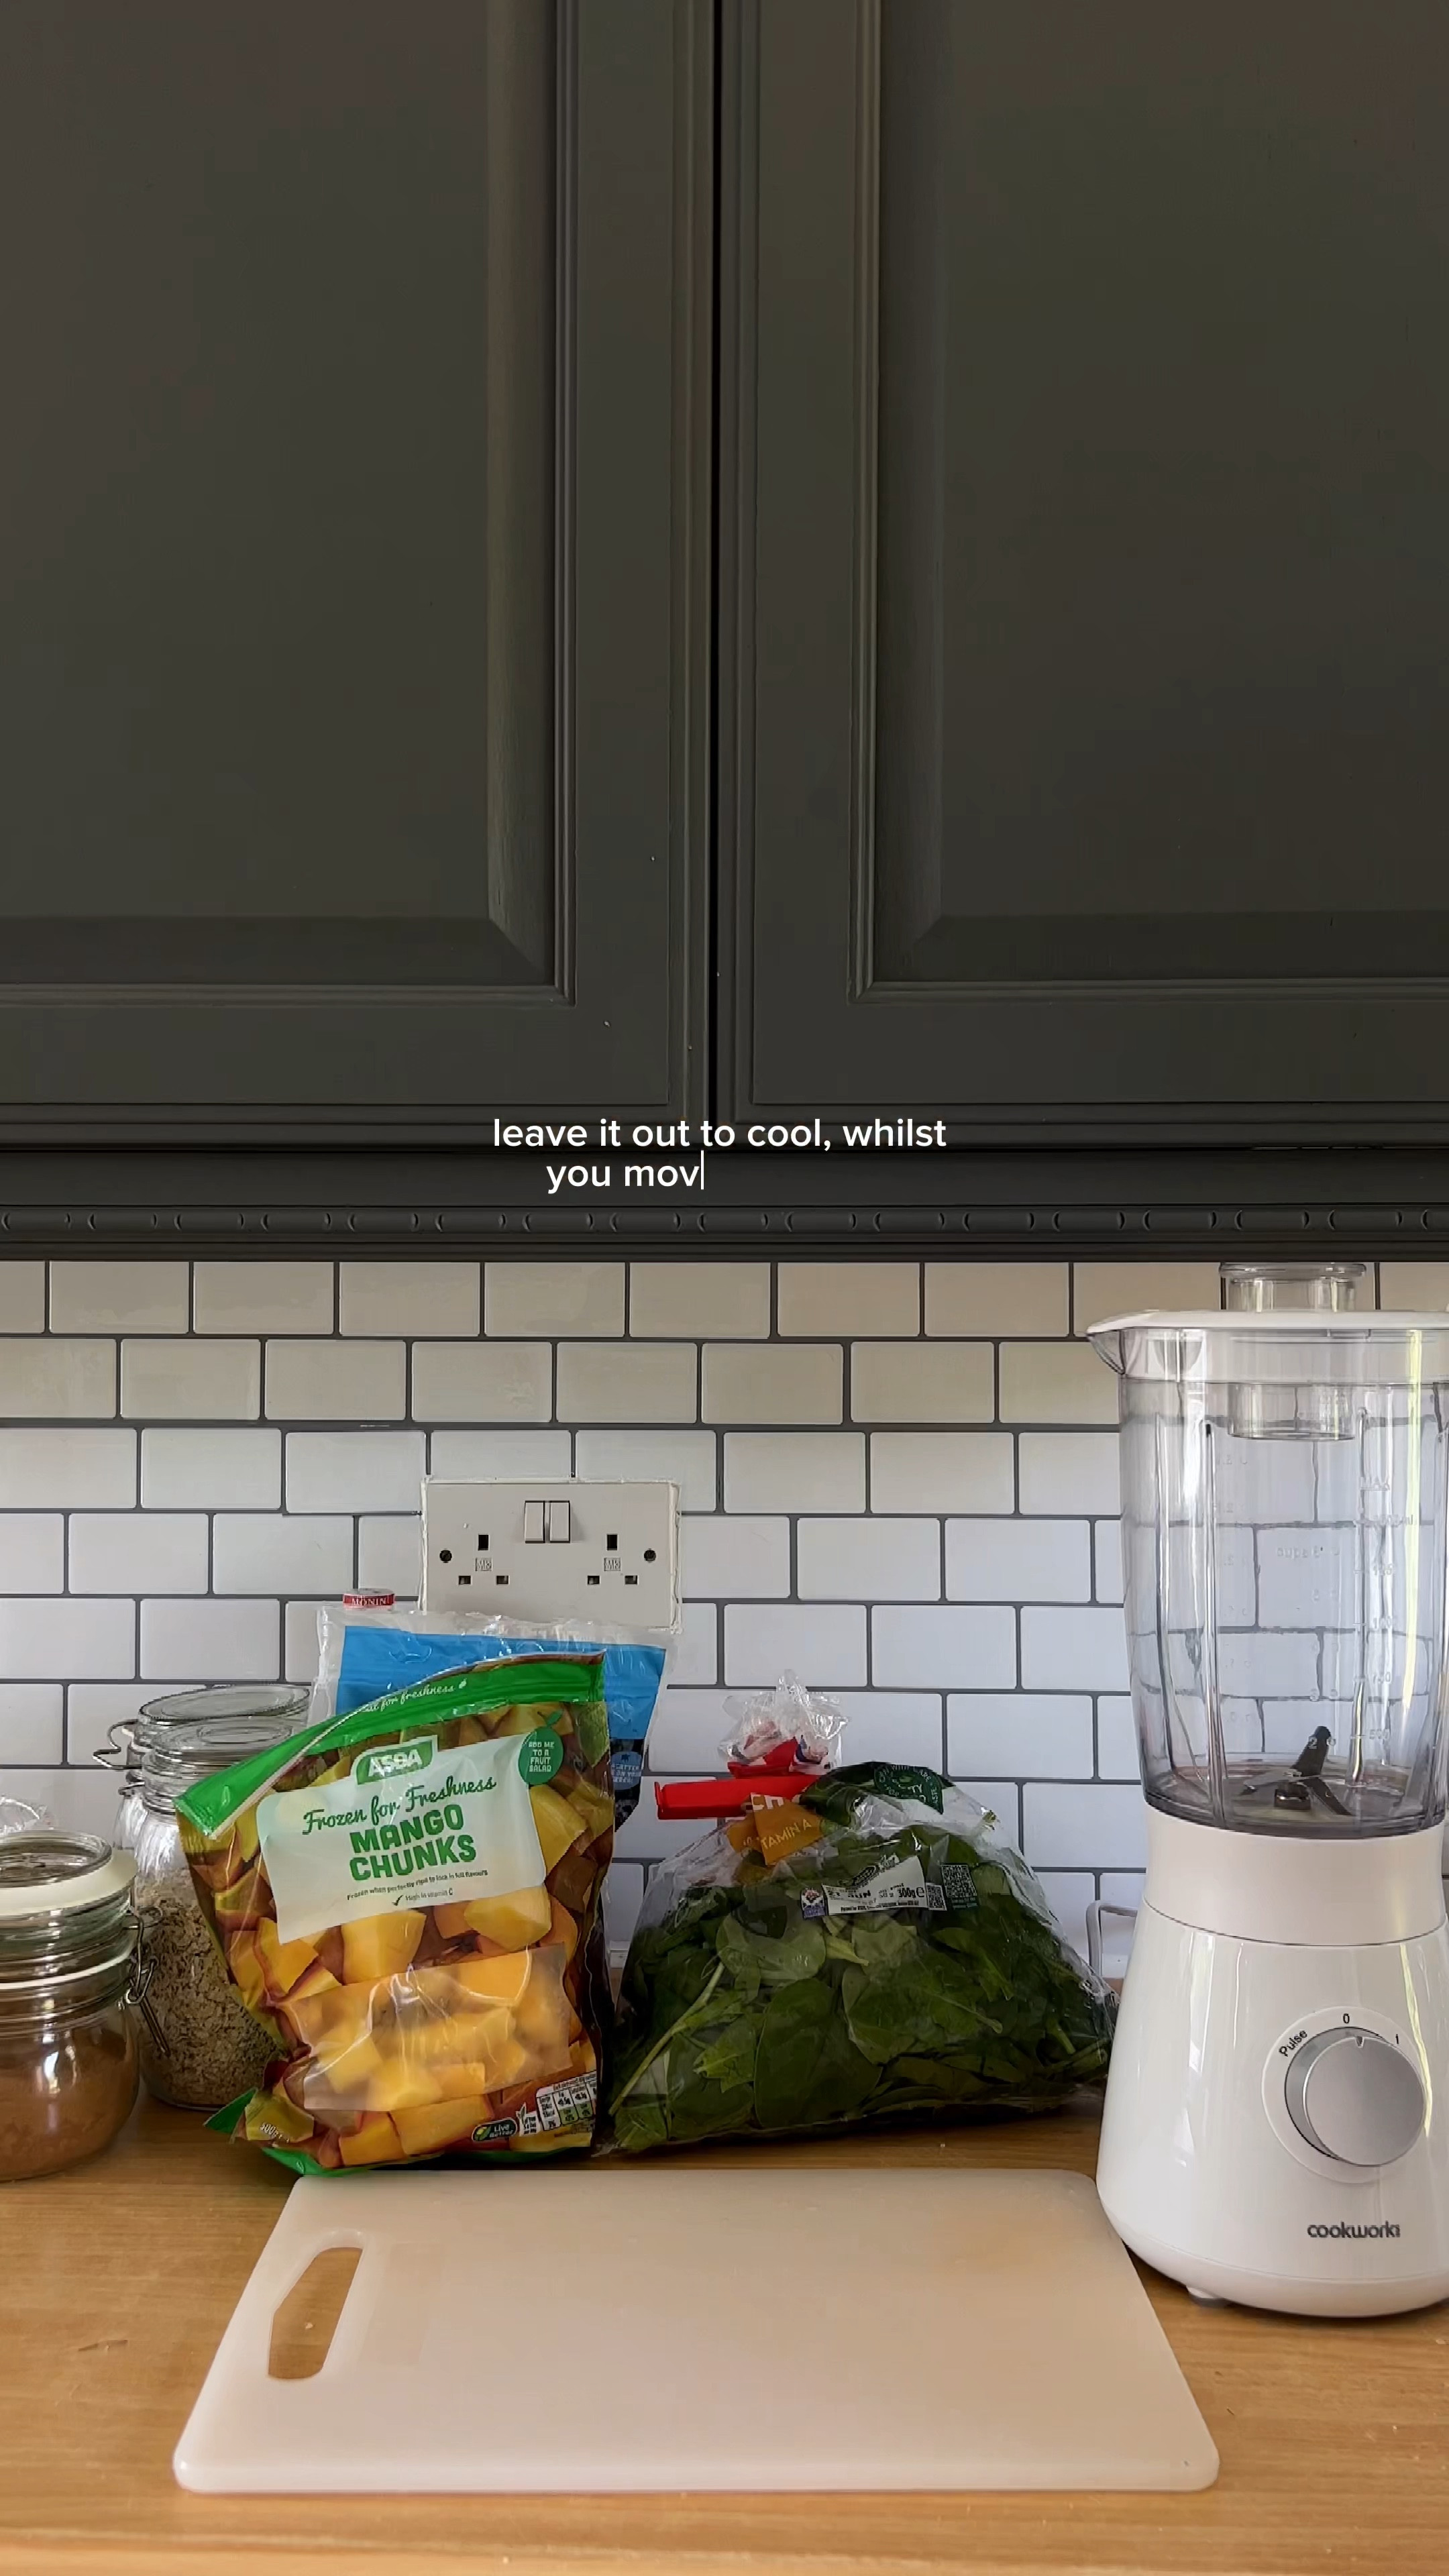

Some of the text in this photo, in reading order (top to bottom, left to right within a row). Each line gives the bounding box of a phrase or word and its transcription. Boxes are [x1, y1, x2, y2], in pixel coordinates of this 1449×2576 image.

[352, 1597, 386, 1605] MONIN
[400, 1684, 455, 1705] freshness
[368, 1749, 423, 1777] ASDA
[302, 1776, 497, 1835] Frozen for Freshness
[350, 1804, 464, 1854] MANGO
[802, 1819, 812, 1831] A
[350, 1834, 477, 1881] CHUNKS
[448, 1887, 453, 1896] C
[1342, 2013, 1350, 2025] 0
[1278, 2030, 1308, 2057] Pulse
[494, 2123, 511, 2132] Live
